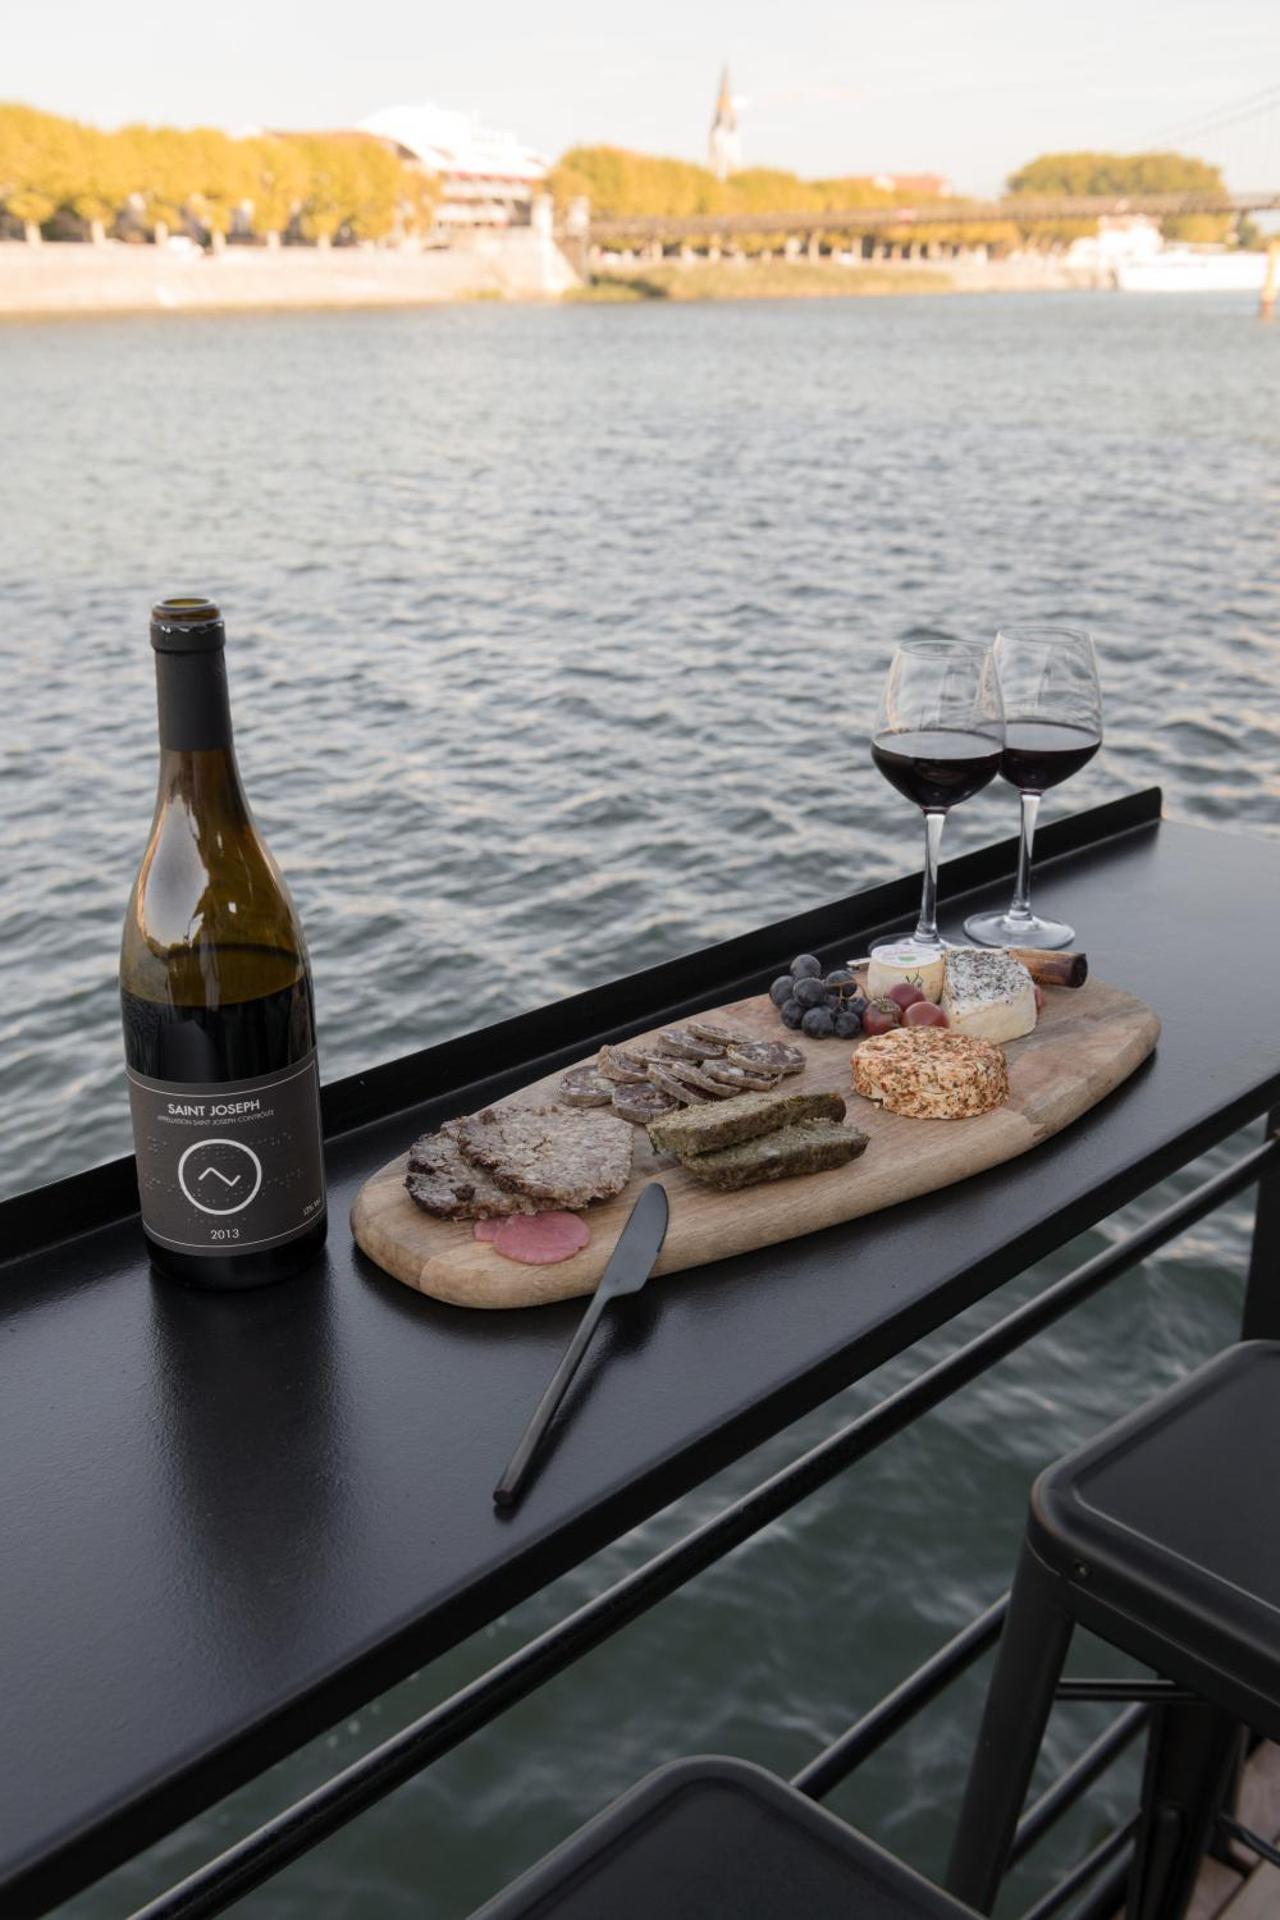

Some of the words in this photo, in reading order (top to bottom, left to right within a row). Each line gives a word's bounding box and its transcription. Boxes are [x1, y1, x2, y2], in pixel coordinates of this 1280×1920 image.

[168, 1103, 205, 1117] SAINT
[210, 1099, 260, 1117] JOSEPH
[210, 1228, 240, 1240] 2013
